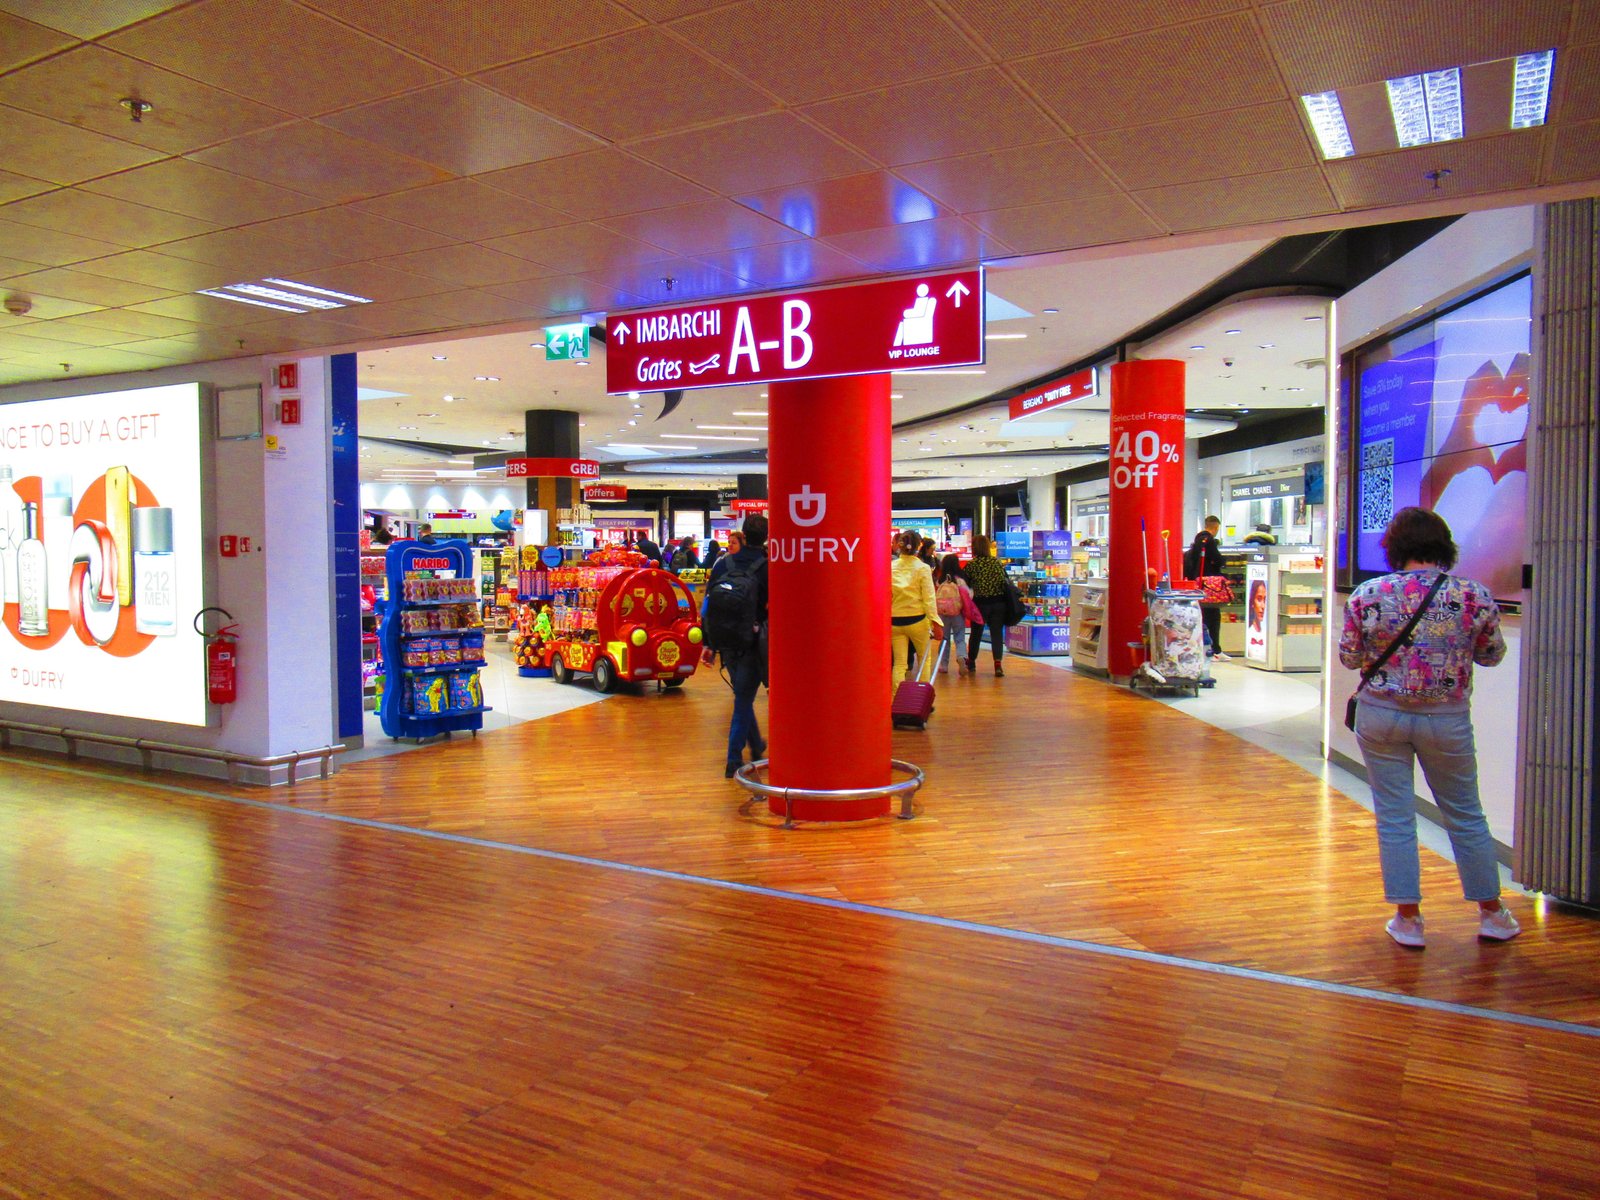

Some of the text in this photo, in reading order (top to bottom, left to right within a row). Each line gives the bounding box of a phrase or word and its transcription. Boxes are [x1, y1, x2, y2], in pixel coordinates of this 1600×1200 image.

[636, 309, 721, 344] IMBARCHI
[727, 299, 814, 375] A-B
[888, 346, 940, 359] VIP LOUNGE
[637, 357, 683, 382] Gates
[1023, 395, 1044, 410] BERGAMO
[31, 424, 54, 447] TO
[60, 419, 94, 446] BUY
[99, 419, 112, 442] A
[116, 413, 160, 441] GIFT
[1113, 464, 1159, 489] Off
[588, 488, 615, 497] Offers
[1232, 487, 1251, 496] CHANEL
[1252, 485, 1273, 494] CHANEL
[770, 538, 861, 563] DUFRY
[412, 557, 450, 569] HARIBO
[144, 571, 169, 591] 212
[144, 591, 170, 606] MEN
[22, 669, 65, 690] DUFRY
